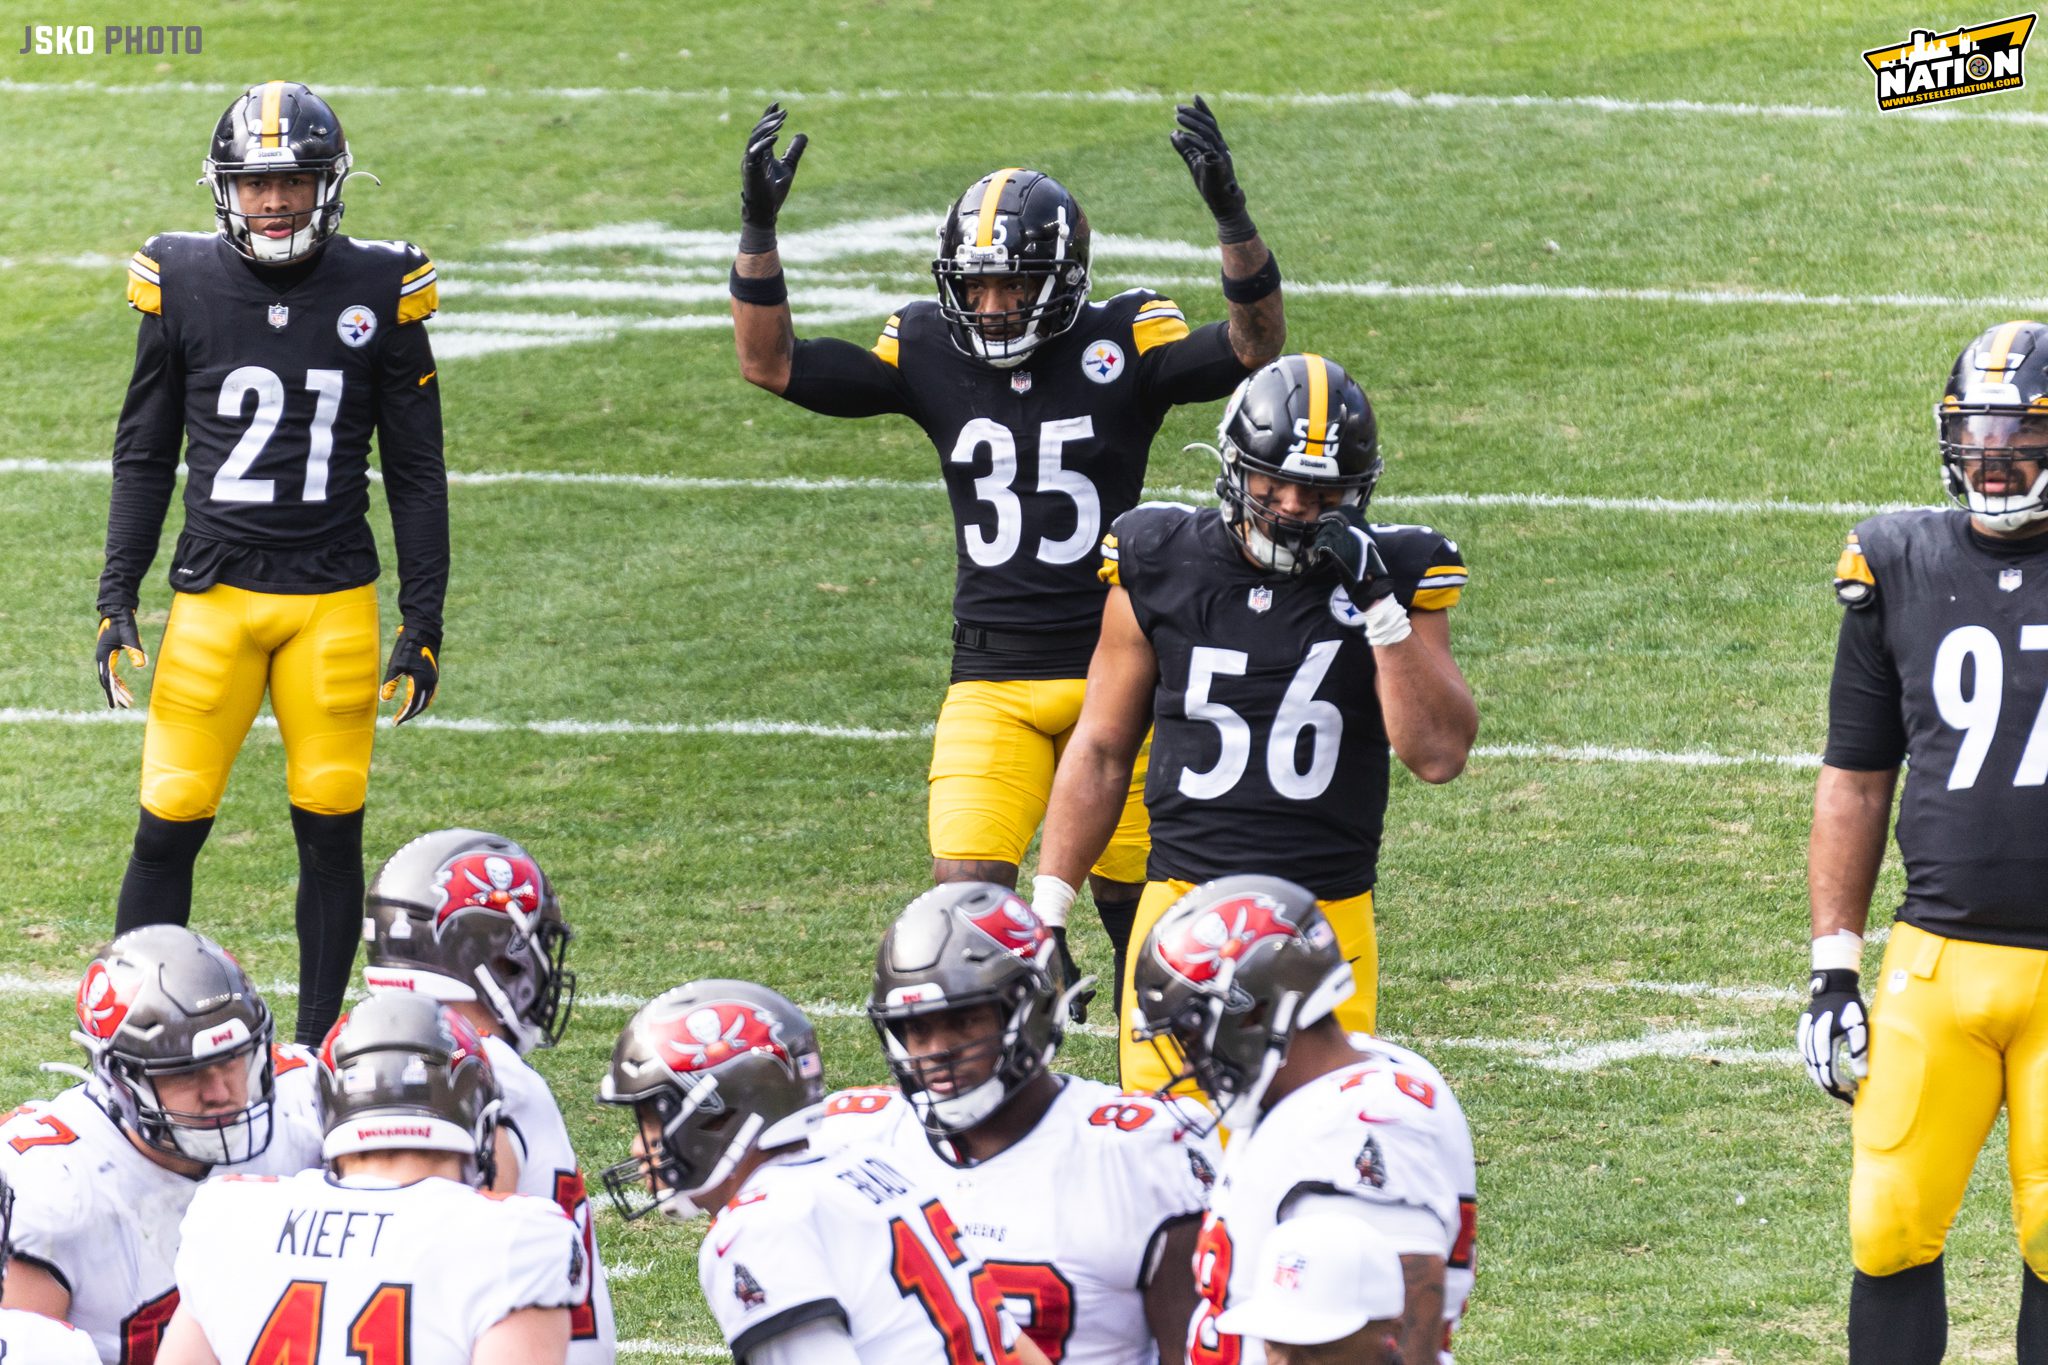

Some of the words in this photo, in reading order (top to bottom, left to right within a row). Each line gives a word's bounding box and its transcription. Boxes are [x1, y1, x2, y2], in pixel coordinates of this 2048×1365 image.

[962, 215, 1008, 246] 35
[210, 365, 344, 502] 21
[1288, 417, 1340, 457] 56
[950, 414, 1101, 567] 35
[1177, 639, 1344, 800] 56
[275, 1208, 395, 1258] KIEFT
